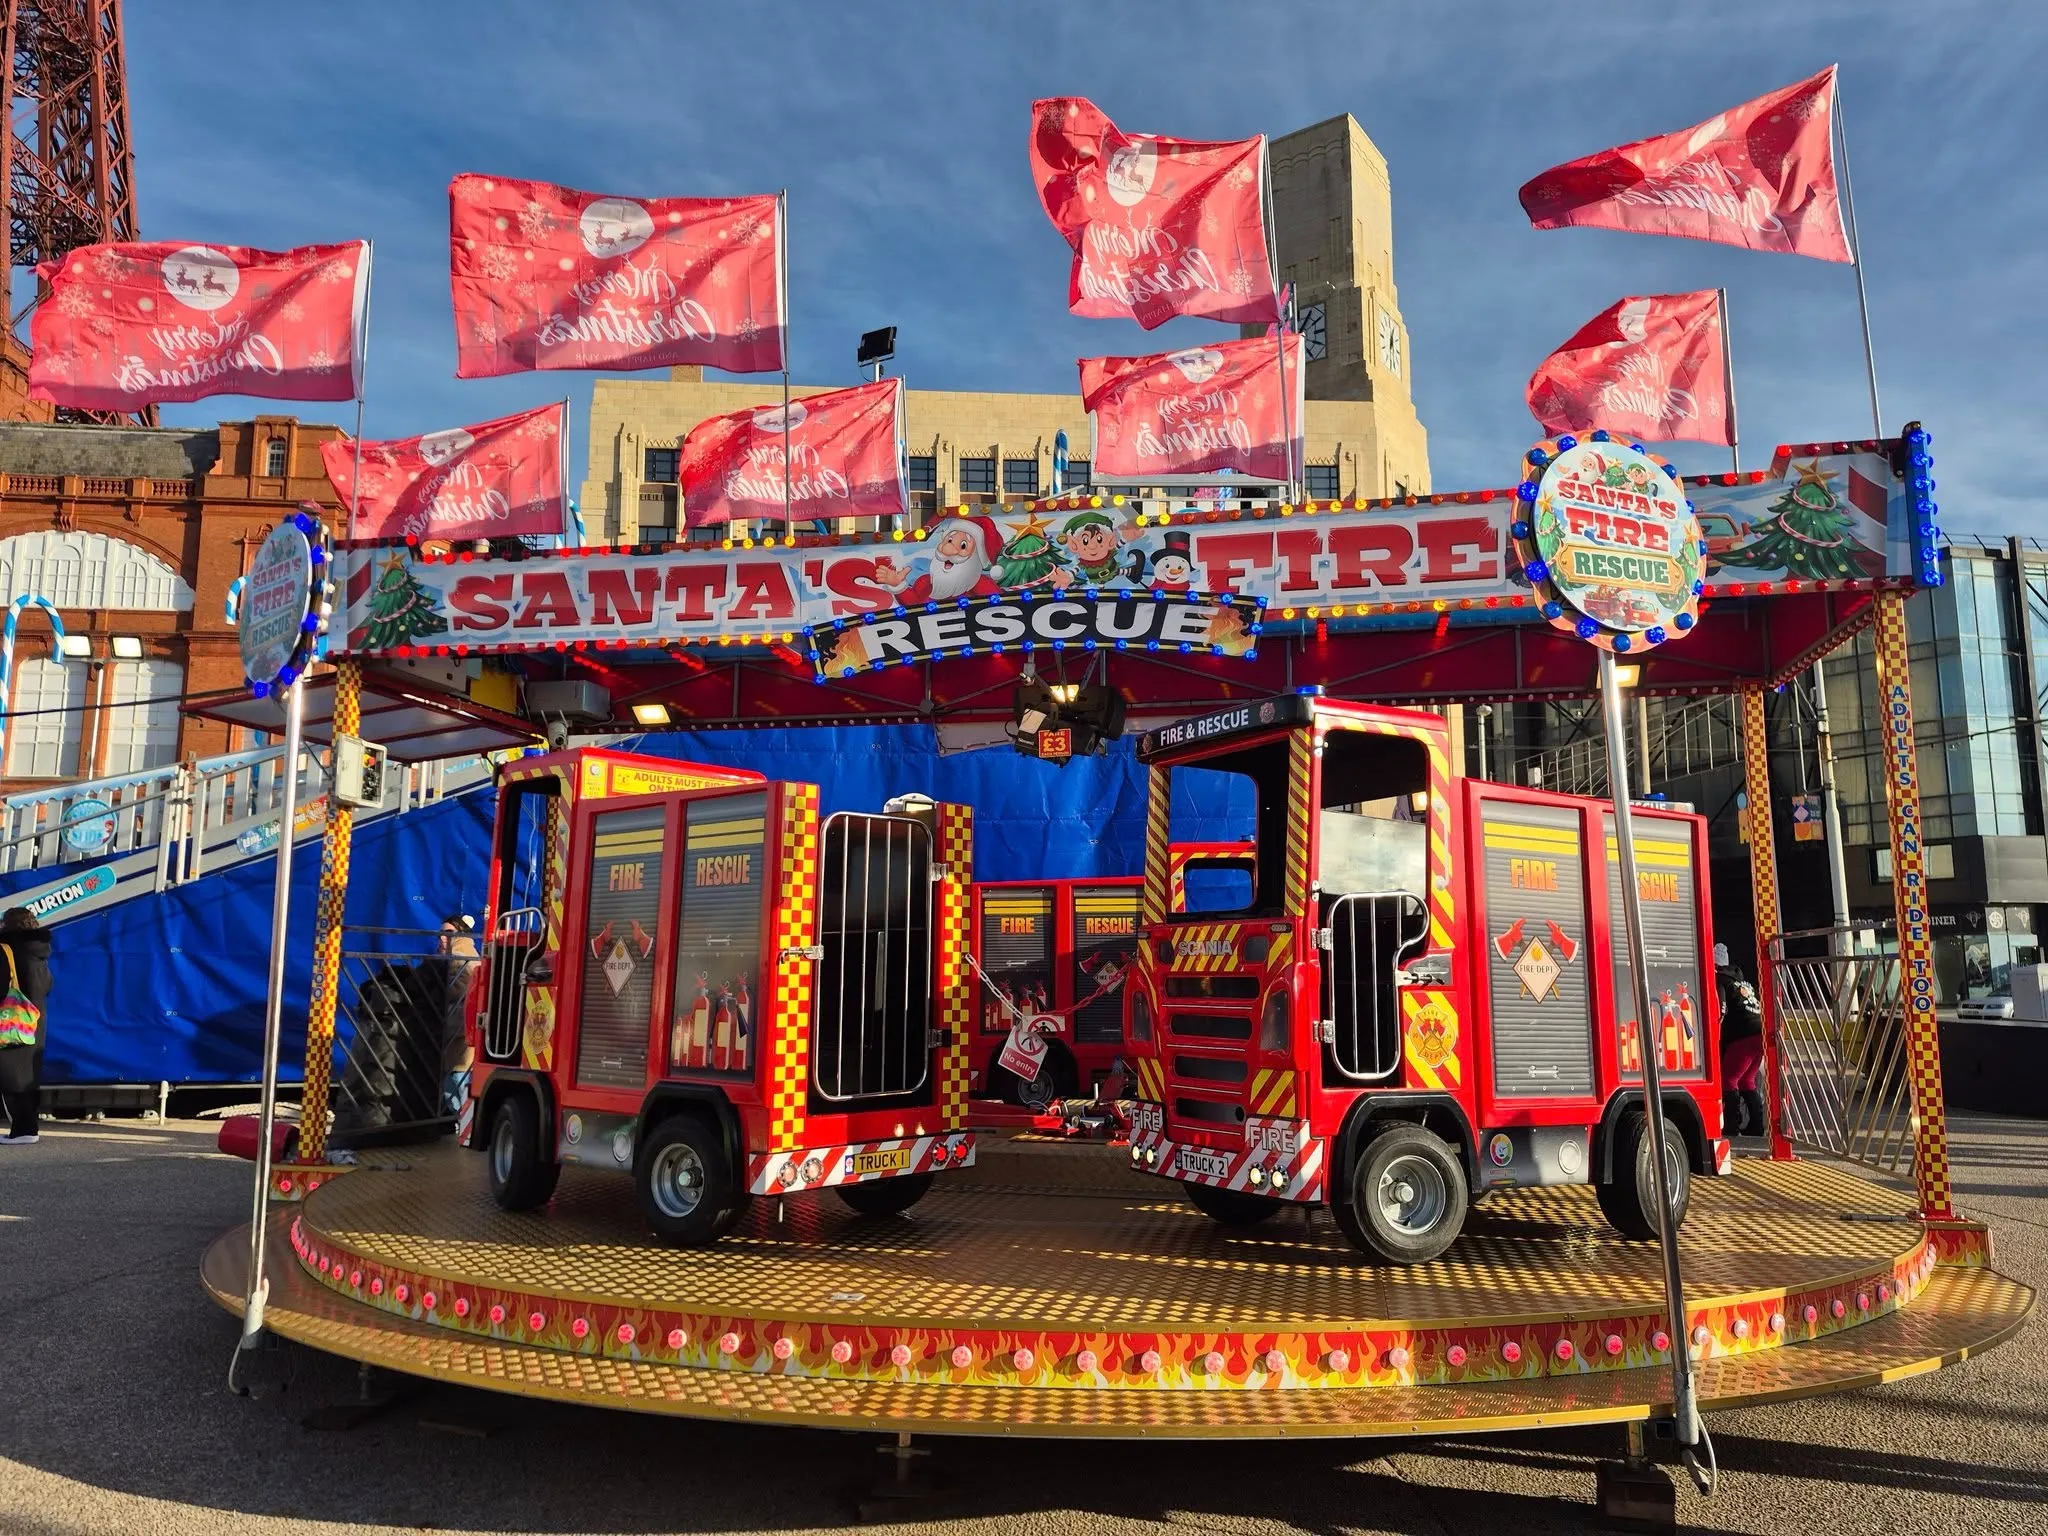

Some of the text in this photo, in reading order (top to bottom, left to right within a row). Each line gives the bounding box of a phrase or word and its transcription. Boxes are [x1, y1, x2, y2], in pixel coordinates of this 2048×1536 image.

[1556, 479, 1677, 520] SANTA'S
[1566, 506, 1669, 551] FIRE
[252, 556, 302, 589] SANTA'S
[448, 517, 1499, 630] SANTA'S FIRE
[1574, 551, 1670, 585] RESCUE
[252, 583, 296, 617] FIRE
[251, 612, 292, 649] RESCUE
[858, 601, 1220, 662] RESCUE
[1160, 708, 1249, 746] FIRE & RESCUE
[1043, 737, 1066, 752] £3
[634, 772, 673, 787] ADULTS
[674, 777, 702, 789] MUST
[1891, 684, 1932, 1012] ADULTS CAN RIDE TOO
[609, 862, 645, 892] FIRE
[696, 854, 751, 888] RESCUE
[1509, 858, 1559, 892] FIRE
[26, 883, 85, 917] BURTON
[318, 889, 331, 943] RIDE
[1000, 916, 1035, 934] FIRE
[1085, 916, 1135, 934] RESCUE
[1178, 940, 1233, 957] SCANIA
[313, 958, 326, 1000] TOO
[1519, 964, 1534, 973] FIRE
[1004, 1052, 1036, 1075] No entry
[1131, 1108, 1162, 1132] FIRE
[1249, 1126, 1295, 1154] FIRE
[859, 1153, 897, 1171] TRUCK
[1184, 1153, 1225, 1175] TRUCK 2
